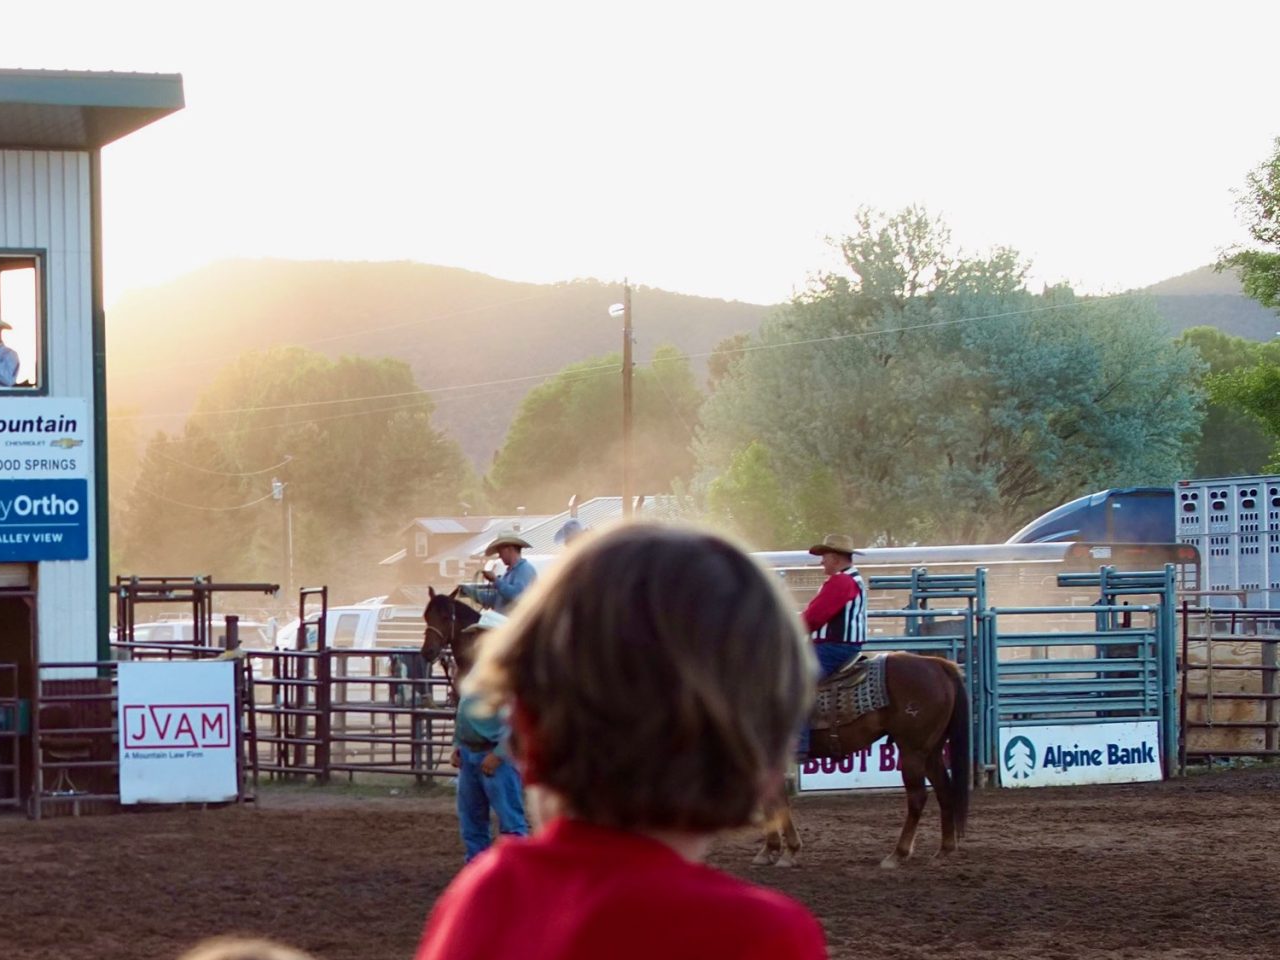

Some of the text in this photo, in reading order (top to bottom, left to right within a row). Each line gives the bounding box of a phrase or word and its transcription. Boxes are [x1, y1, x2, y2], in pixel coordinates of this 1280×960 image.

[25, 459, 77, 471] SPRINGS
[33, 533, 64, 543] VIEW
[132, 705, 223, 747] JVAM
[132, 752, 167, 760] Mountain
[169, 751, 185, 759] Law
[186, 750, 204, 758] Firm
[1043, 741, 1155, 772] Alpine Bank
